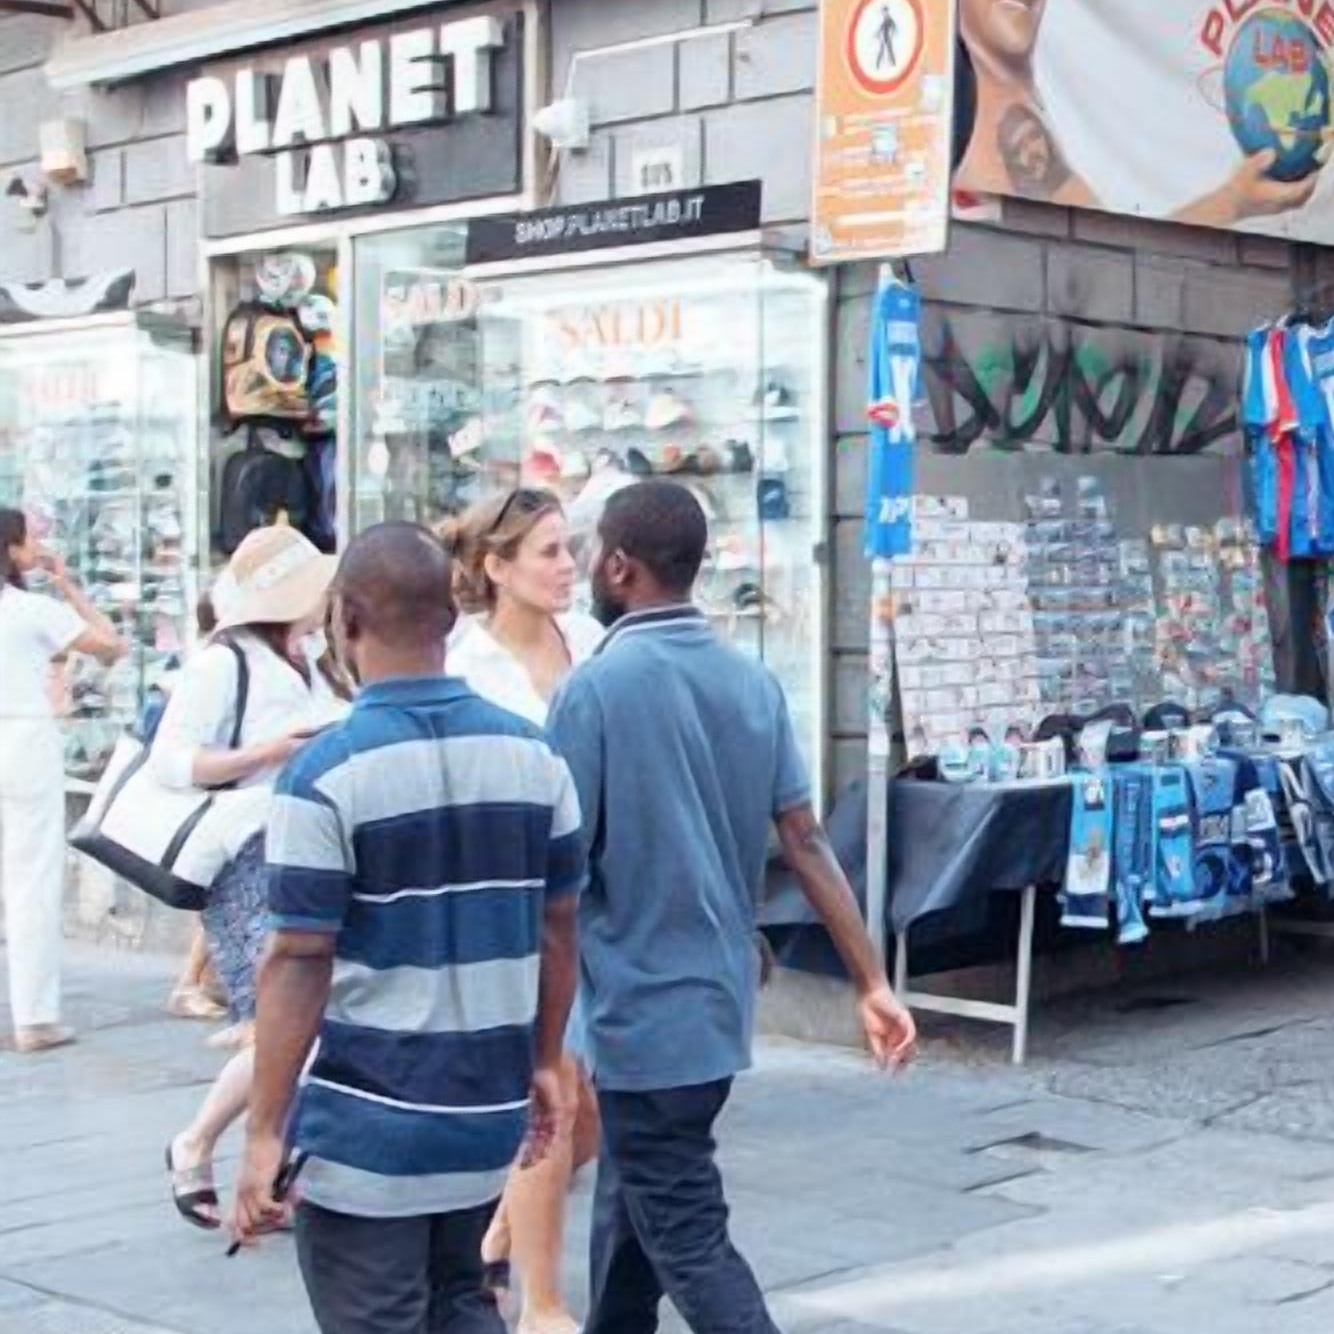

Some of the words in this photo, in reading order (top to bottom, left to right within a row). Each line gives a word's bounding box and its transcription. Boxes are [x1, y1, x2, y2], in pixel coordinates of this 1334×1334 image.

[1254, 27, 1308, 74] LAB
[187, 15, 503, 164] PLANET
[276, 138, 396, 215] LAB
